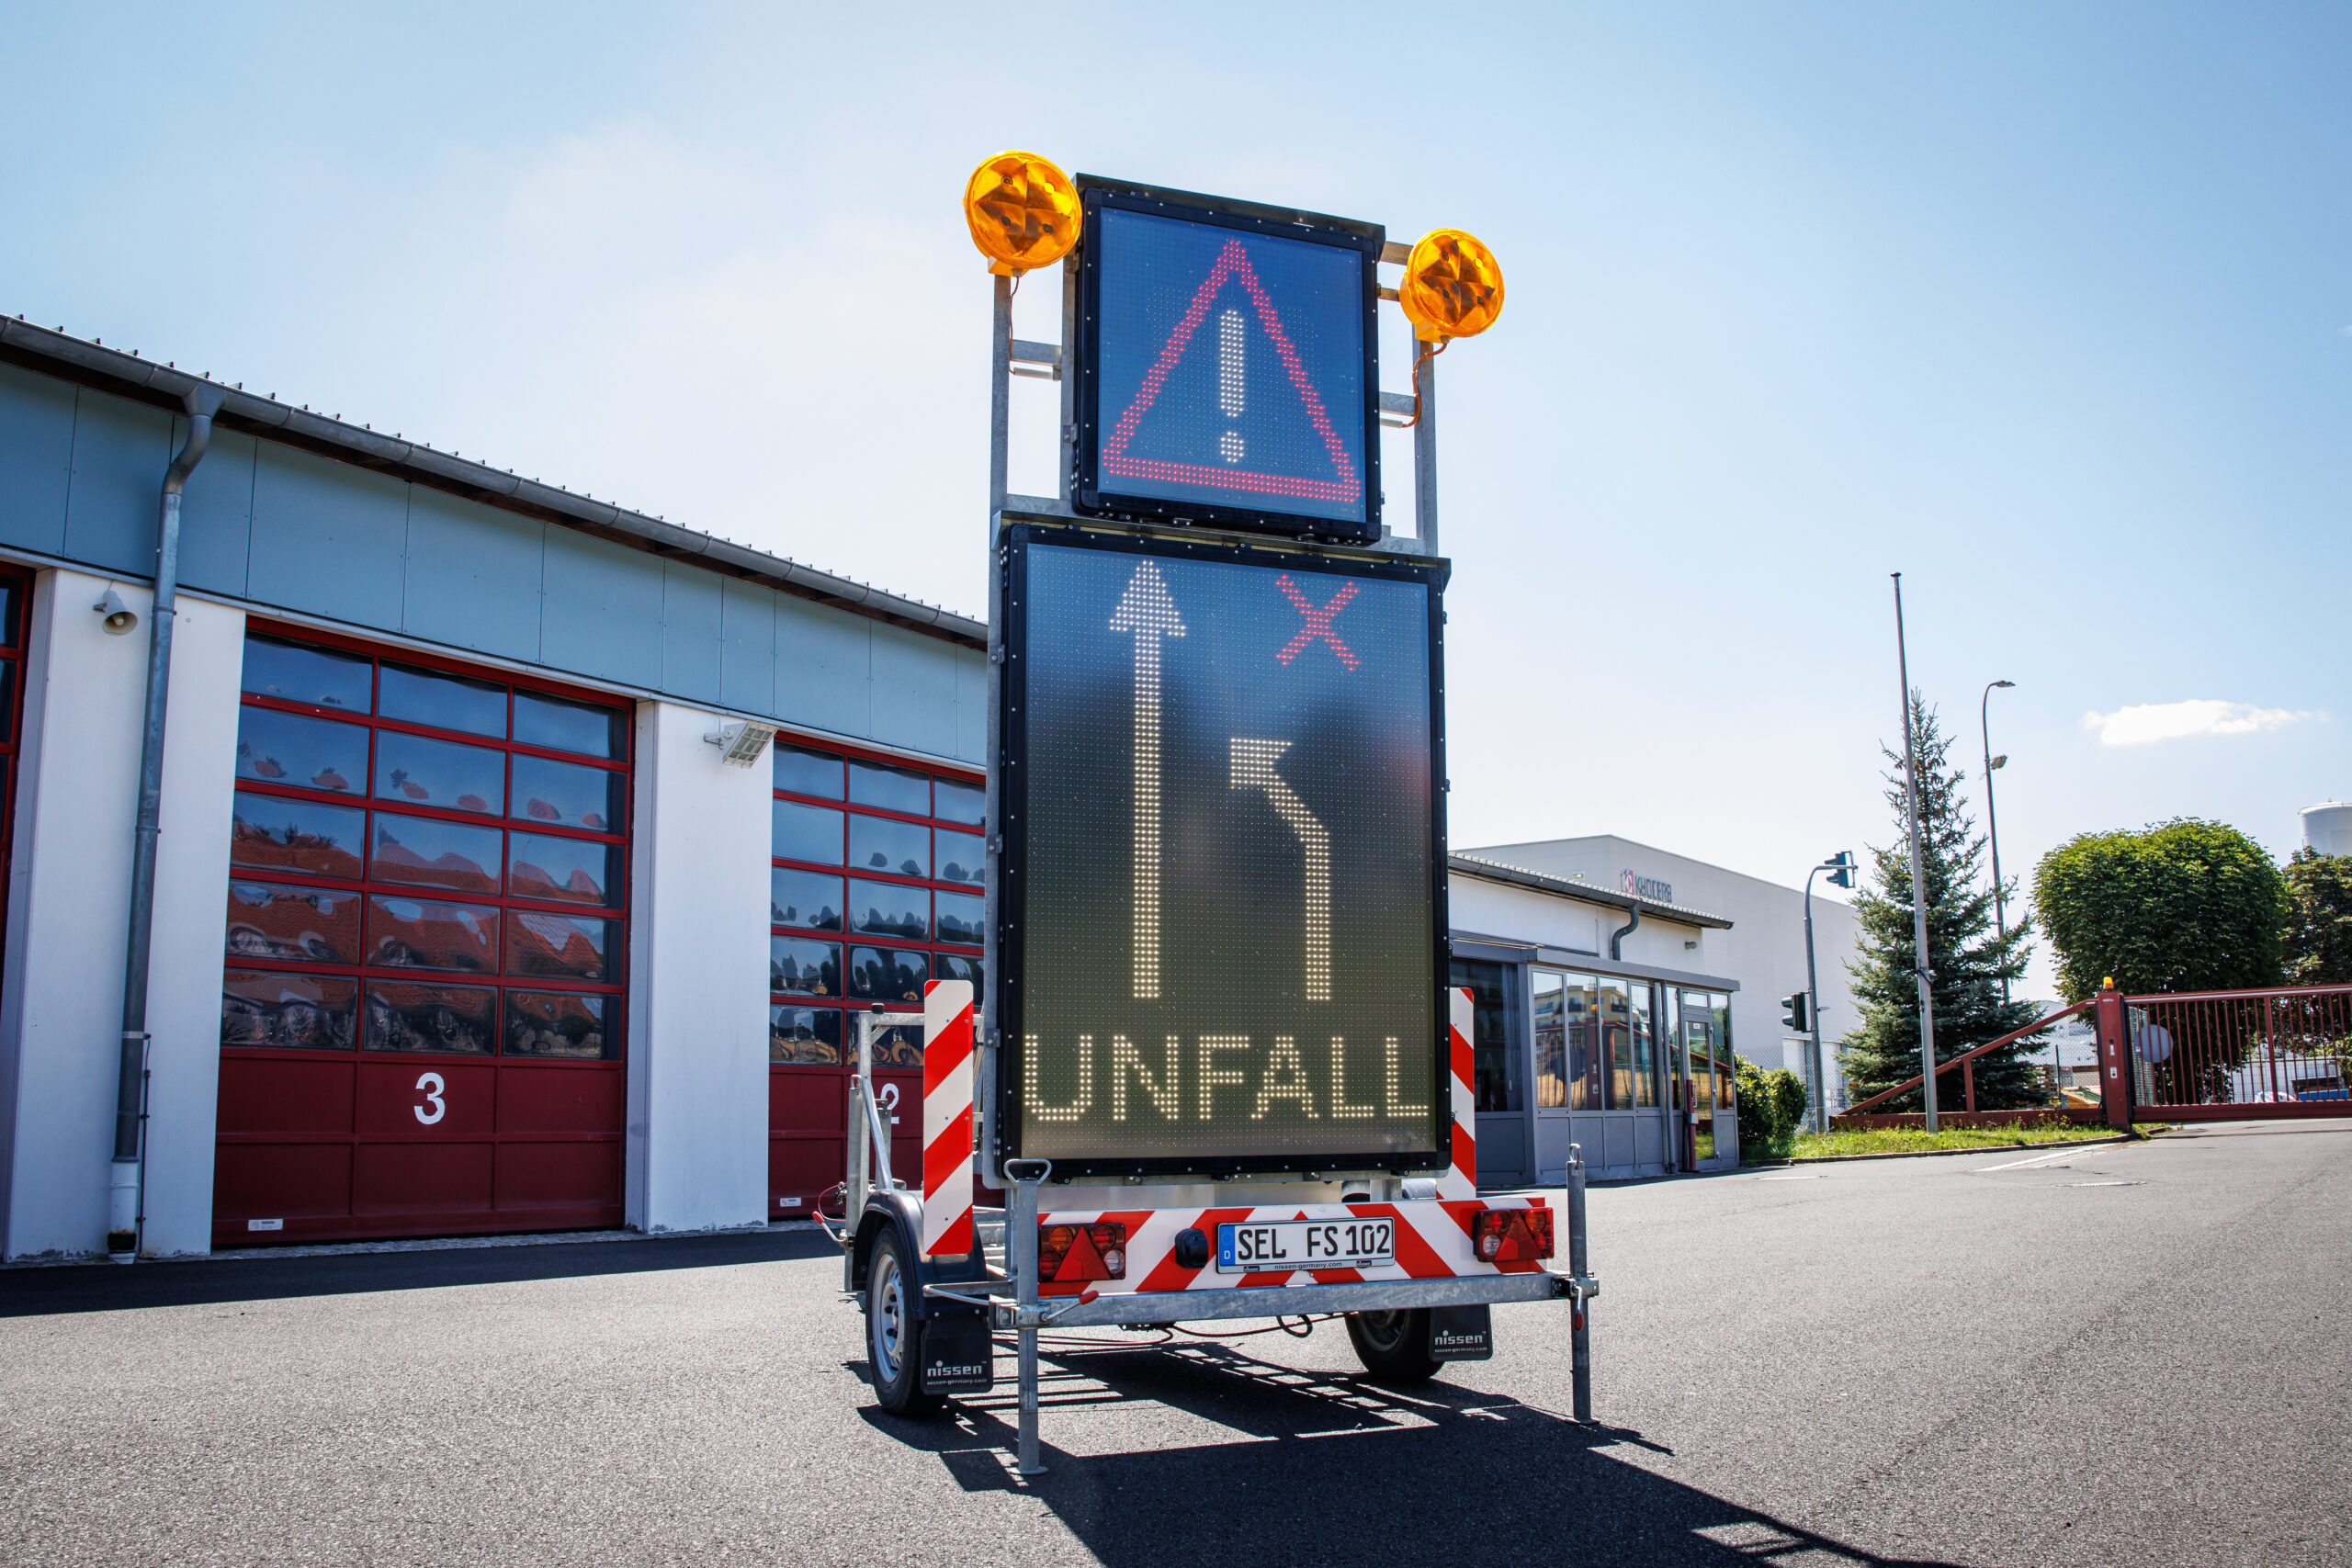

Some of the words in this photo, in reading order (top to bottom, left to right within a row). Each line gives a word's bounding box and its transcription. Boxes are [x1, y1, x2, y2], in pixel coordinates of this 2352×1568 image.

[1635, 874, 1672, 903] KYOCERA
[1024, 1034, 1430, 1122] UNFALL
[413, 1072, 446, 1125] 3
[879, 1083, 899, 1124] 2
[1224, 1250, 1231, 1260] D
[1238, 1229, 1286, 1260] SEL
[1307, 1226, 1339, 1258] FS
[1345, 1224, 1390, 1255] 102
[1274, 1261, 1342, 1270] nissen-germany.com
[1434, 1330, 1483, 1346] nissen
[927, 1359, 982, 1377] nissen
